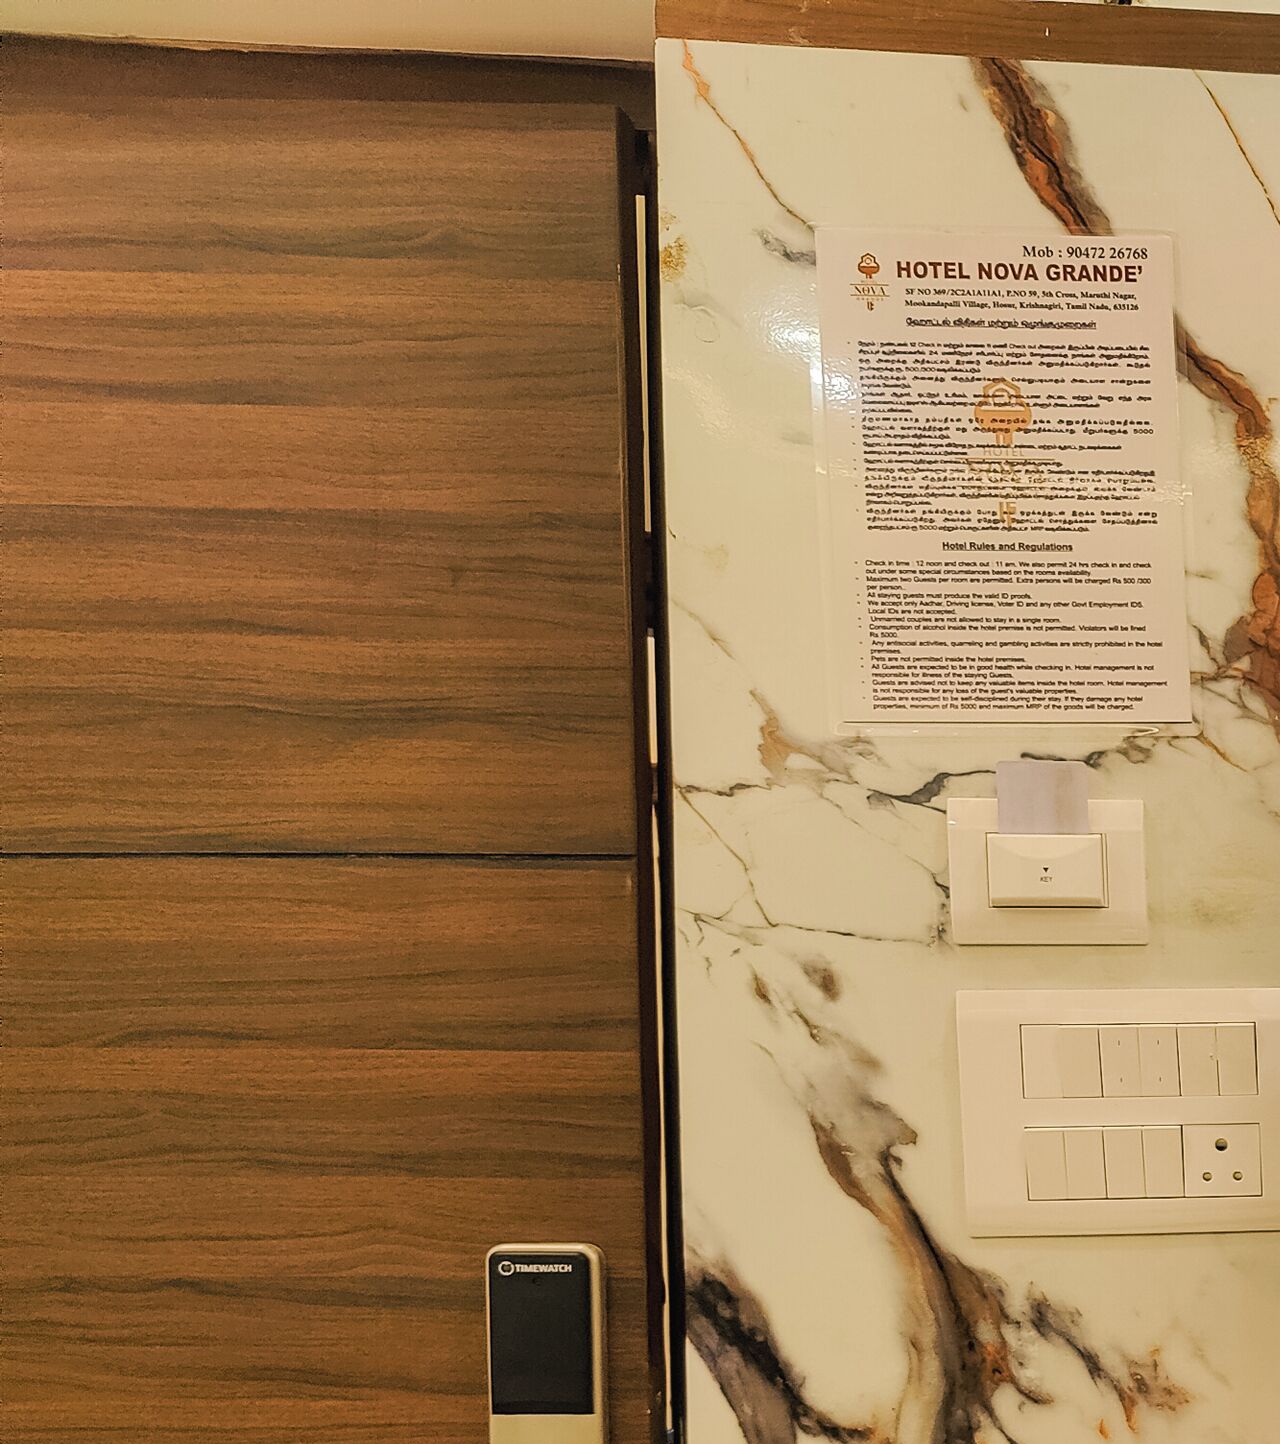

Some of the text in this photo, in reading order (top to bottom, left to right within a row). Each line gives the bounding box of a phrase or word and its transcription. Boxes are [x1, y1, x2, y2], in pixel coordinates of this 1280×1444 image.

[1023, 246, 1053, 257] Mob
[1067, 247, 1105, 258] 90472
[1110, 247, 1148, 259] 26768
[897, 261, 970, 279] HOTEL
[978, 262, 1039, 281] NOVA
[854, 286, 886, 295] NOVA
[1055, 291, 1078, 299] Cross,
[1113, 292, 1136, 300] Nagar,
[905, 300, 1139, 311] Mookandapalli Village, Hosur, Krishnagiri, Tamil Nadu, 635126
[942, 541, 1073, 552] Hotel Rules and Regulations
[864, 559, 886, 567] Check
[887, 559, 894, 567] in
[895, 559, 910, 567] time
[1046, 560, 1067, 569] permit
[1068, 560, 1077, 568] 24
[865, 567, 876, 575] out
[877, 567, 896, 575] under
[918, 568, 941, 576] special
[1023, 568, 1034, 576] the
[865, 575, 898, 583] Maximum
[899, 575, 912, 583] two
[938, 577, 949, 585] per
[1035, 577, 1061, 585] persons
[1062, 576, 1073, 584] will
[1084, 577, 1111, 585] charged
[866, 584, 877, 592] per
[877, 591, 901, 600] staying
[902, 591, 924, 600] guests
[943, 592, 970, 601] produce
[515, 1264, 572, 1273] TIMEWATCH
